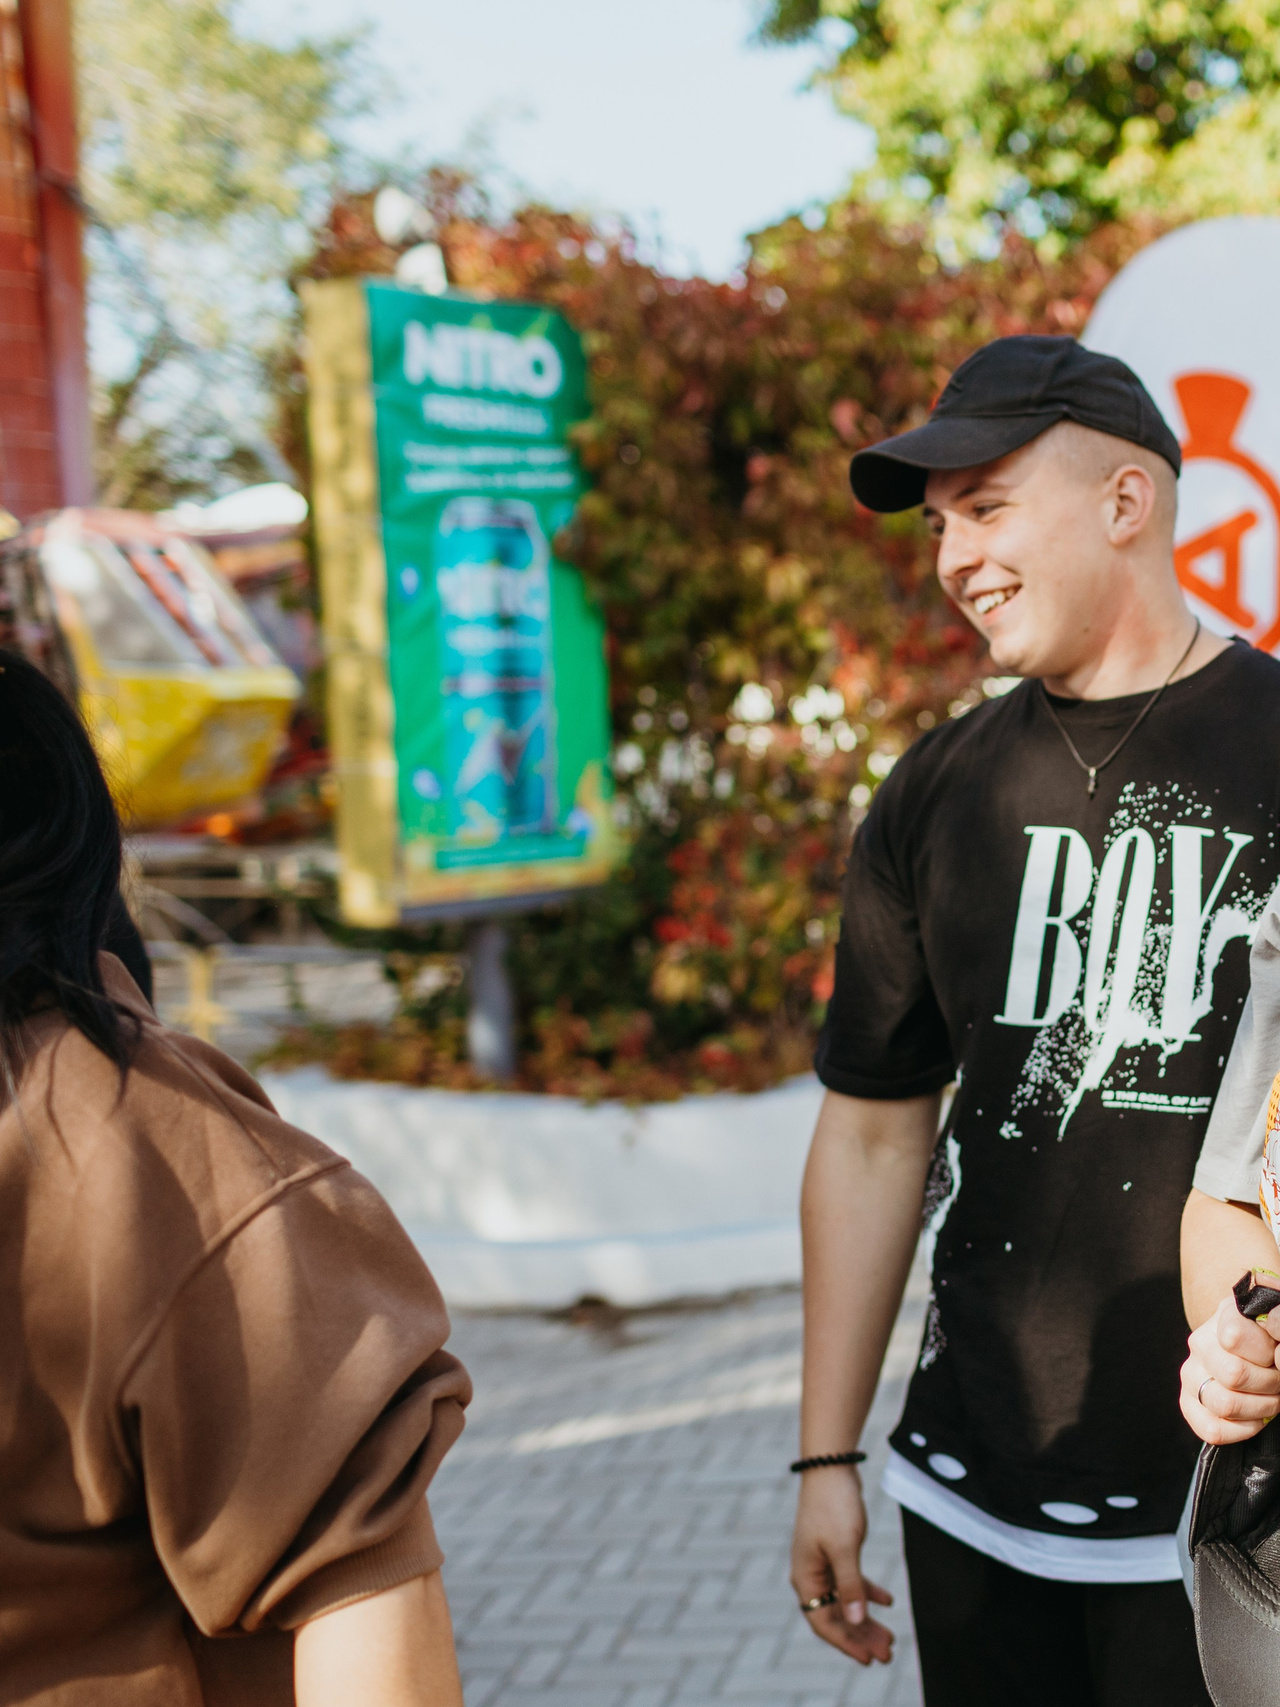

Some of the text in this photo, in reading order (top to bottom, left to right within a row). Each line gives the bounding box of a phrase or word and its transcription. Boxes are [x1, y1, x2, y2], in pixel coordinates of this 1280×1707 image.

[403, 320, 562, 399] NITRO
[1115, 1091, 1138, 1102] THE
[1138, 1092, 1170, 1105] SOUL
[1171, 1096, 1189, 1106] OF
